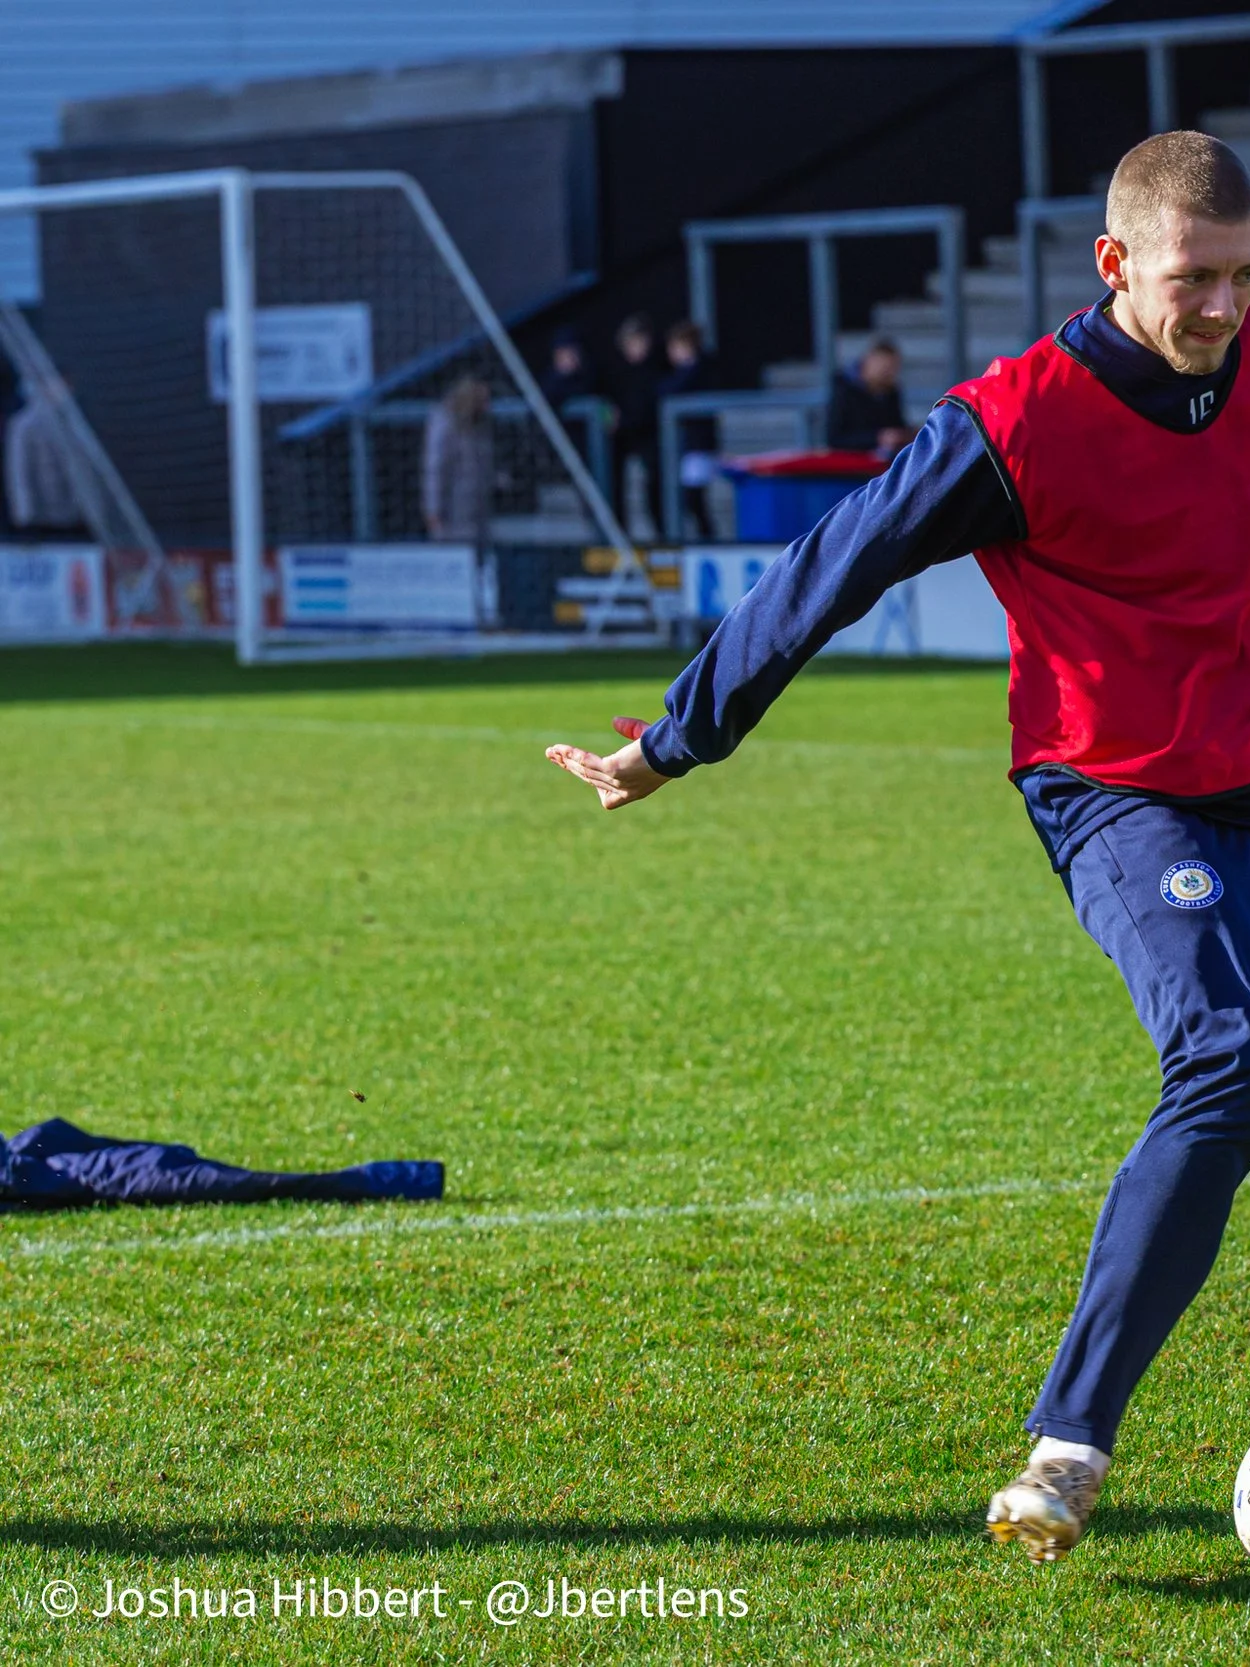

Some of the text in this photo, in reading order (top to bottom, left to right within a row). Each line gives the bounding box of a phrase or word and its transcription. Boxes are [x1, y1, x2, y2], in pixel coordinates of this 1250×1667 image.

[1162, 862, 1211, 894] CURZON ASHTON
[1174, 896, 1215, 906] FOOTBALL
